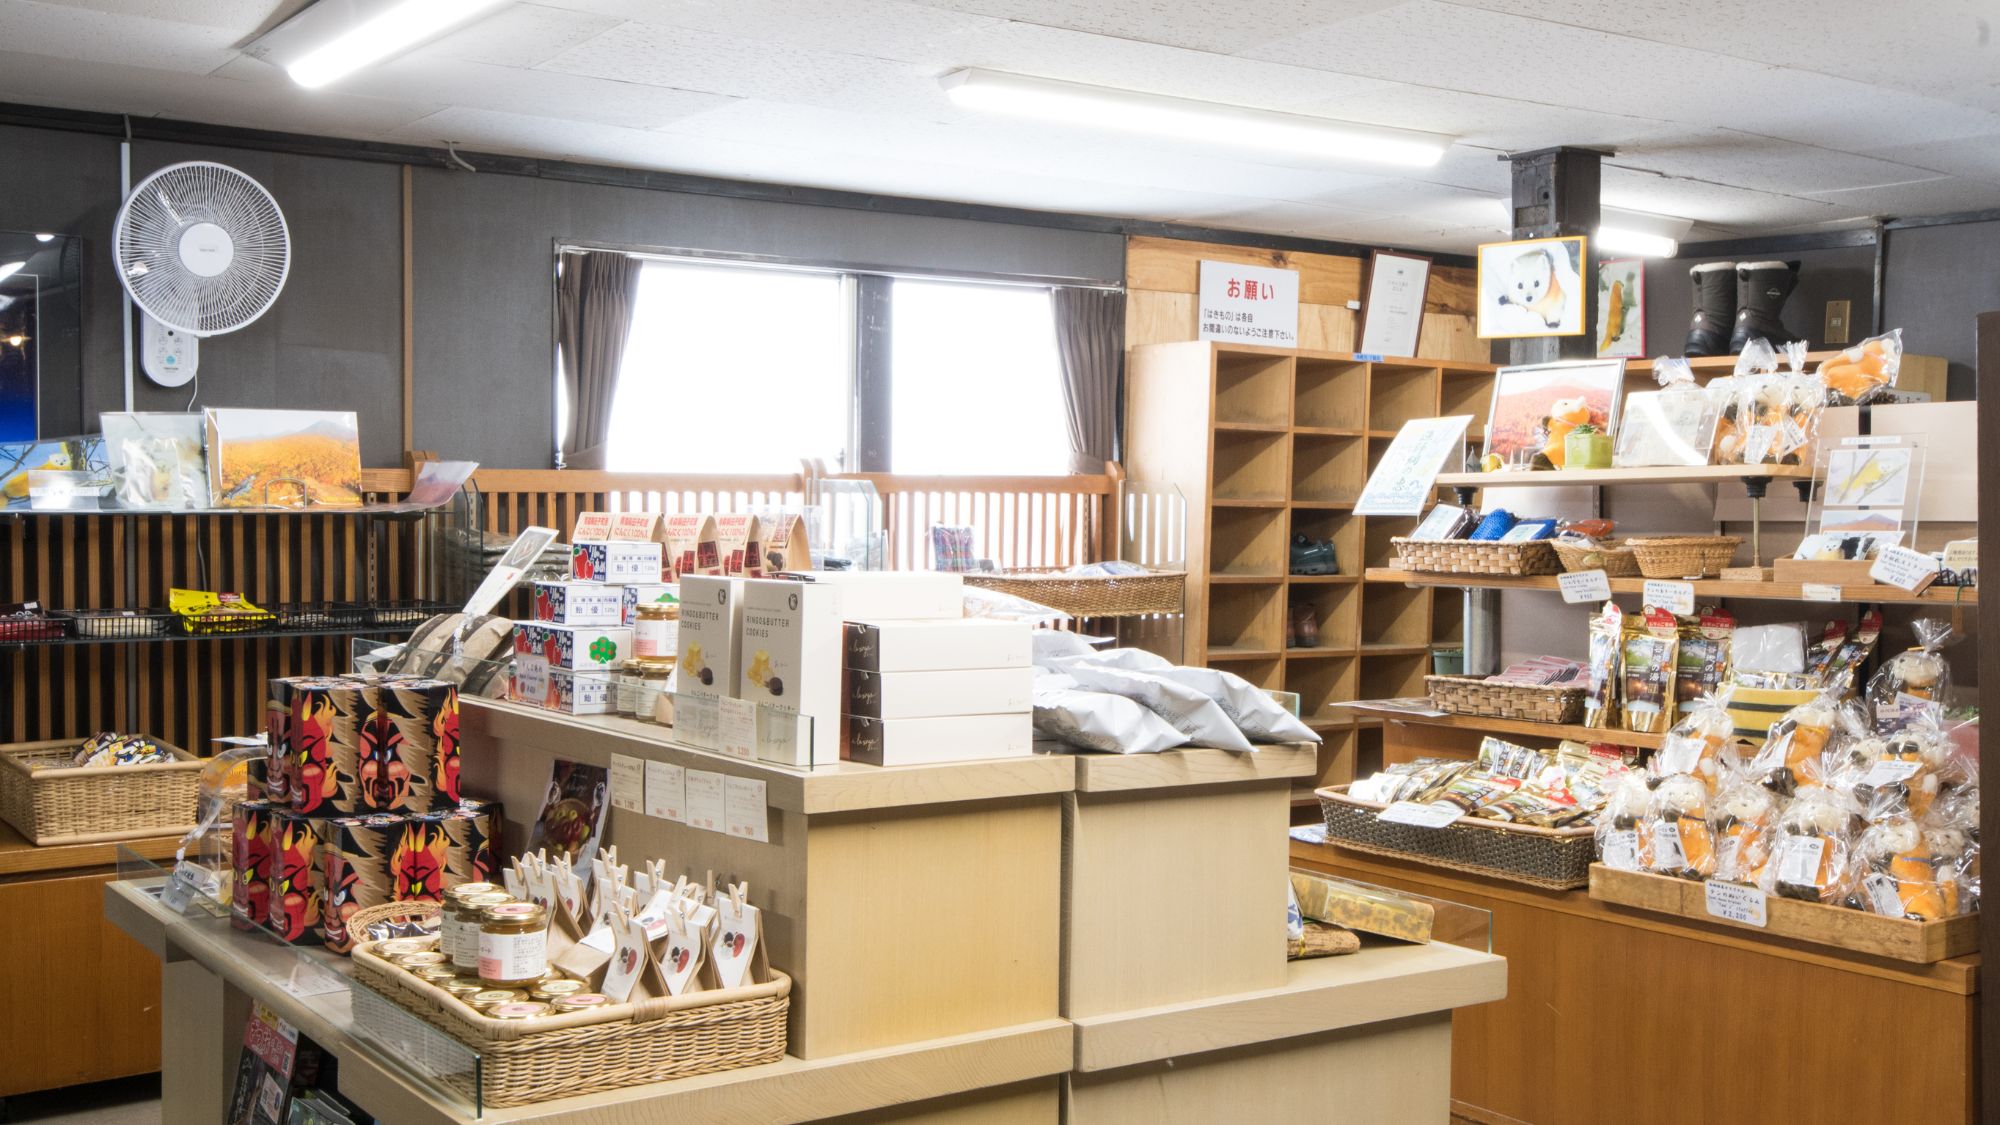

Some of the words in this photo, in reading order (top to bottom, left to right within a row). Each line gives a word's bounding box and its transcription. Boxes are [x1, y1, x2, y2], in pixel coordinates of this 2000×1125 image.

[1227, 277, 1275, 300] お願い
[1203, 309, 1253, 323] 「はきもの」は各自
[1202, 322, 1295, 341] お間違いのないようご注意下さい。
[680, 620, 702, 631] COOKIES
[746, 615, 790, 628] RINGO&BUTTER
[746, 627, 769, 639] COOKIES
